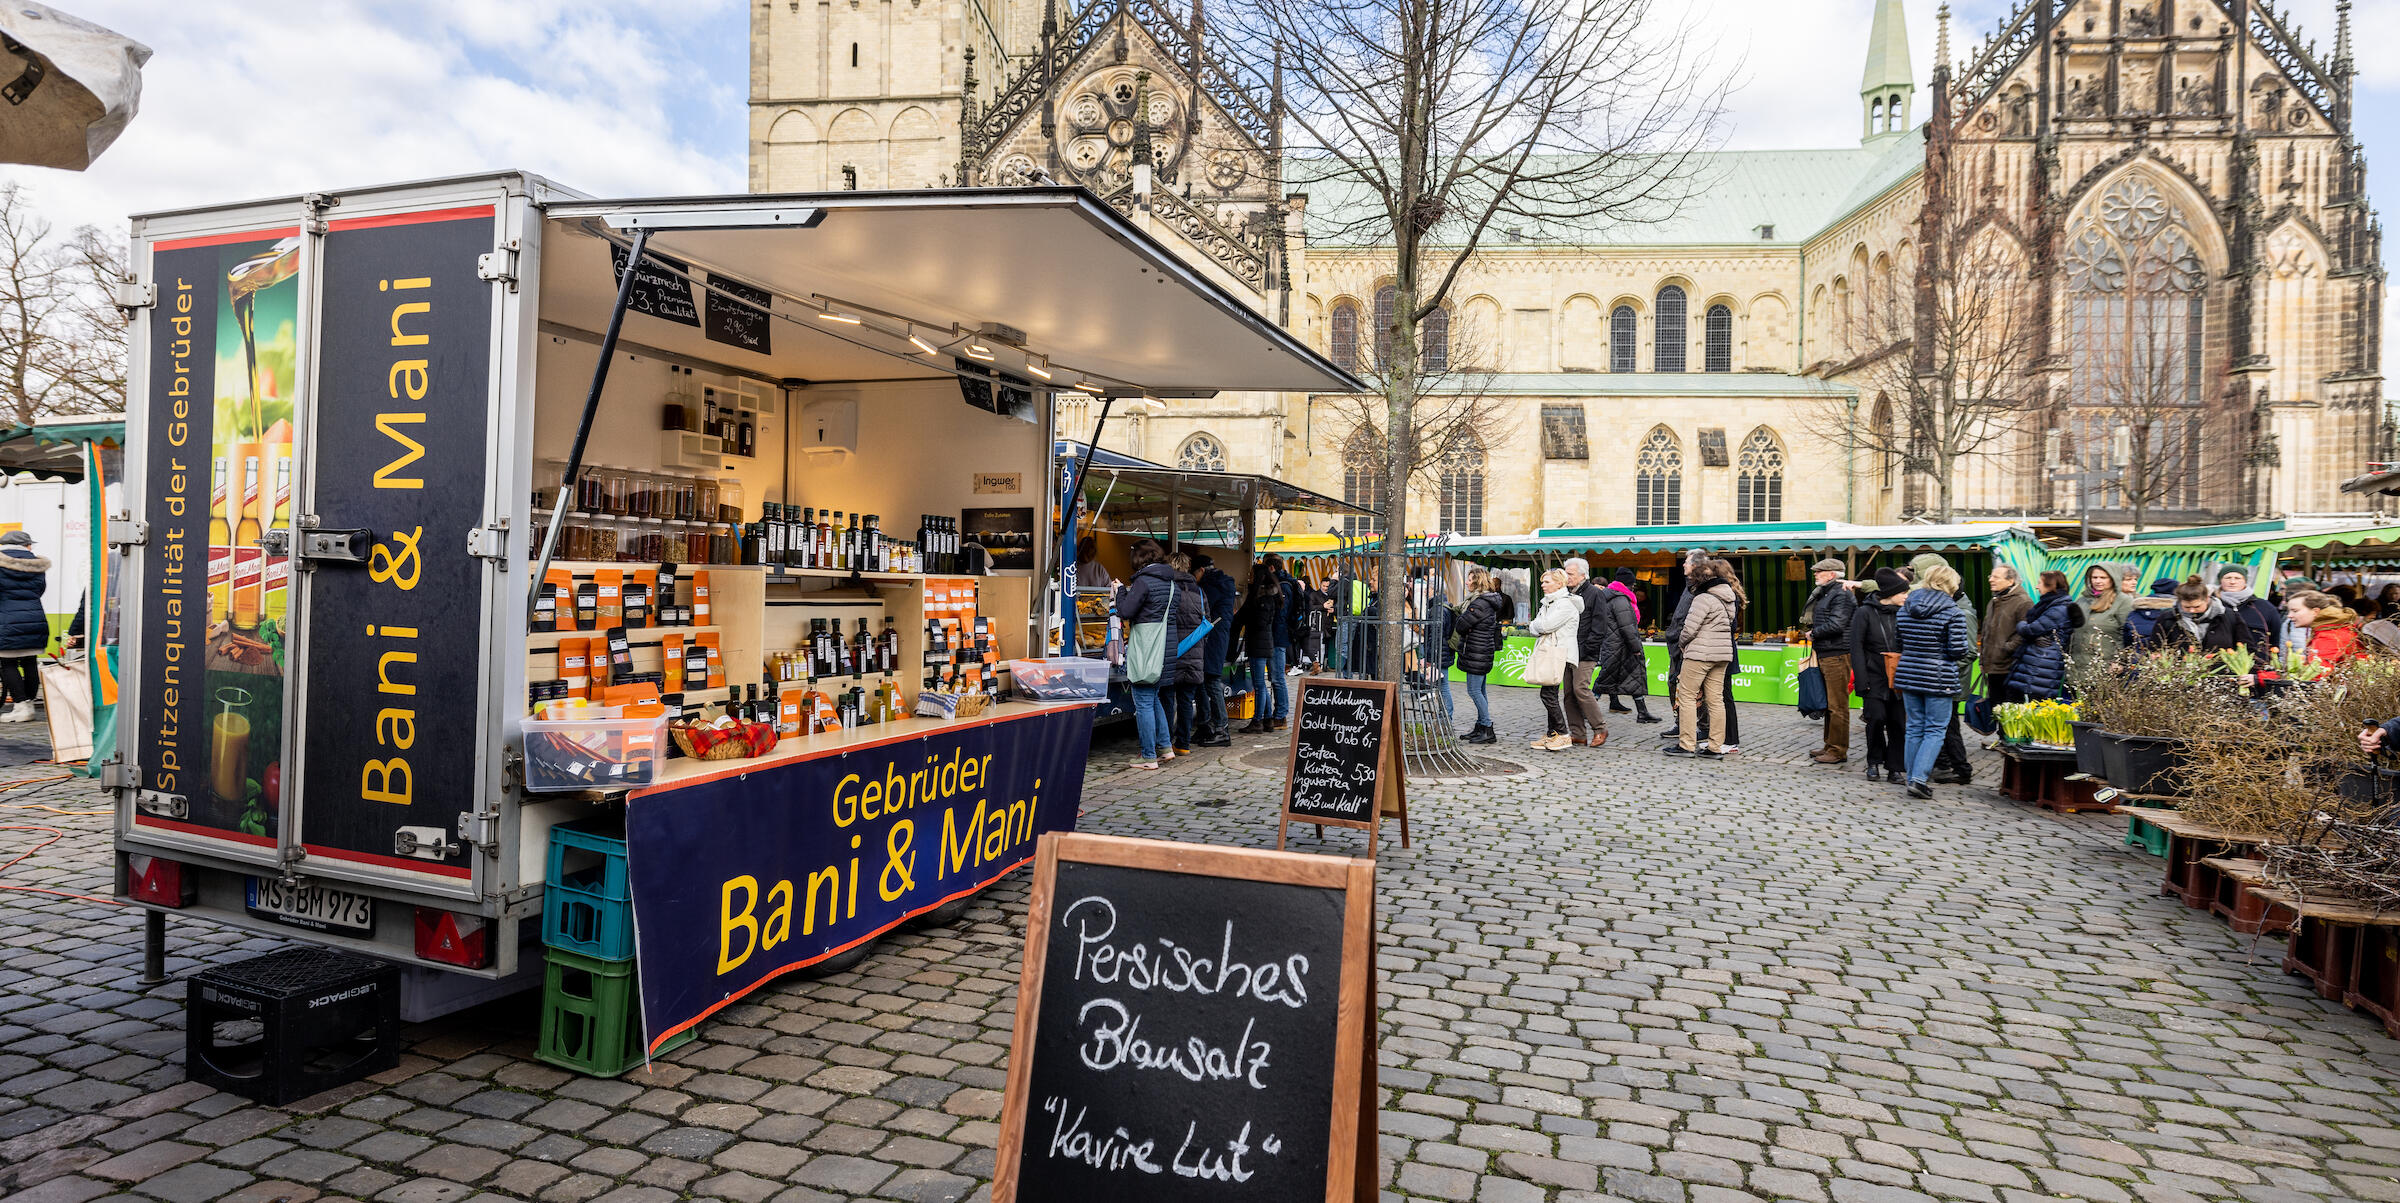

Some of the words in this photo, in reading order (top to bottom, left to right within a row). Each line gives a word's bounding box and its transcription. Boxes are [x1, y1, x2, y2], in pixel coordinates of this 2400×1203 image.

[167, 277, 193, 447] Gebrüder
[373, 276, 431, 489] Mani
[165, 457, 188, 517] der
[983, 476, 1014, 487] Ingwer
[368, 525, 423, 591] &
[157, 526, 186, 791] Spitzenqualität
[362, 624, 418, 806] Bani
[1344, 733, 1359, 746] ab
[1352, 705, 1382, 725] 16,95
[832, 746, 993, 828] Gebrüder
[1350, 763, 1376, 786] 5,30
[258, 877, 283, 909] MS
[296, 886, 325, 917] BM
[328, 890, 369, 925] 973
[716, 834, 863, 977] Bani
[878, 818, 917, 902] &
[937, 779, 1042, 881] Mani
[1062, 895, 1310, 1008] Persisches
[1077, 996, 1272, 1092] Blausalz
